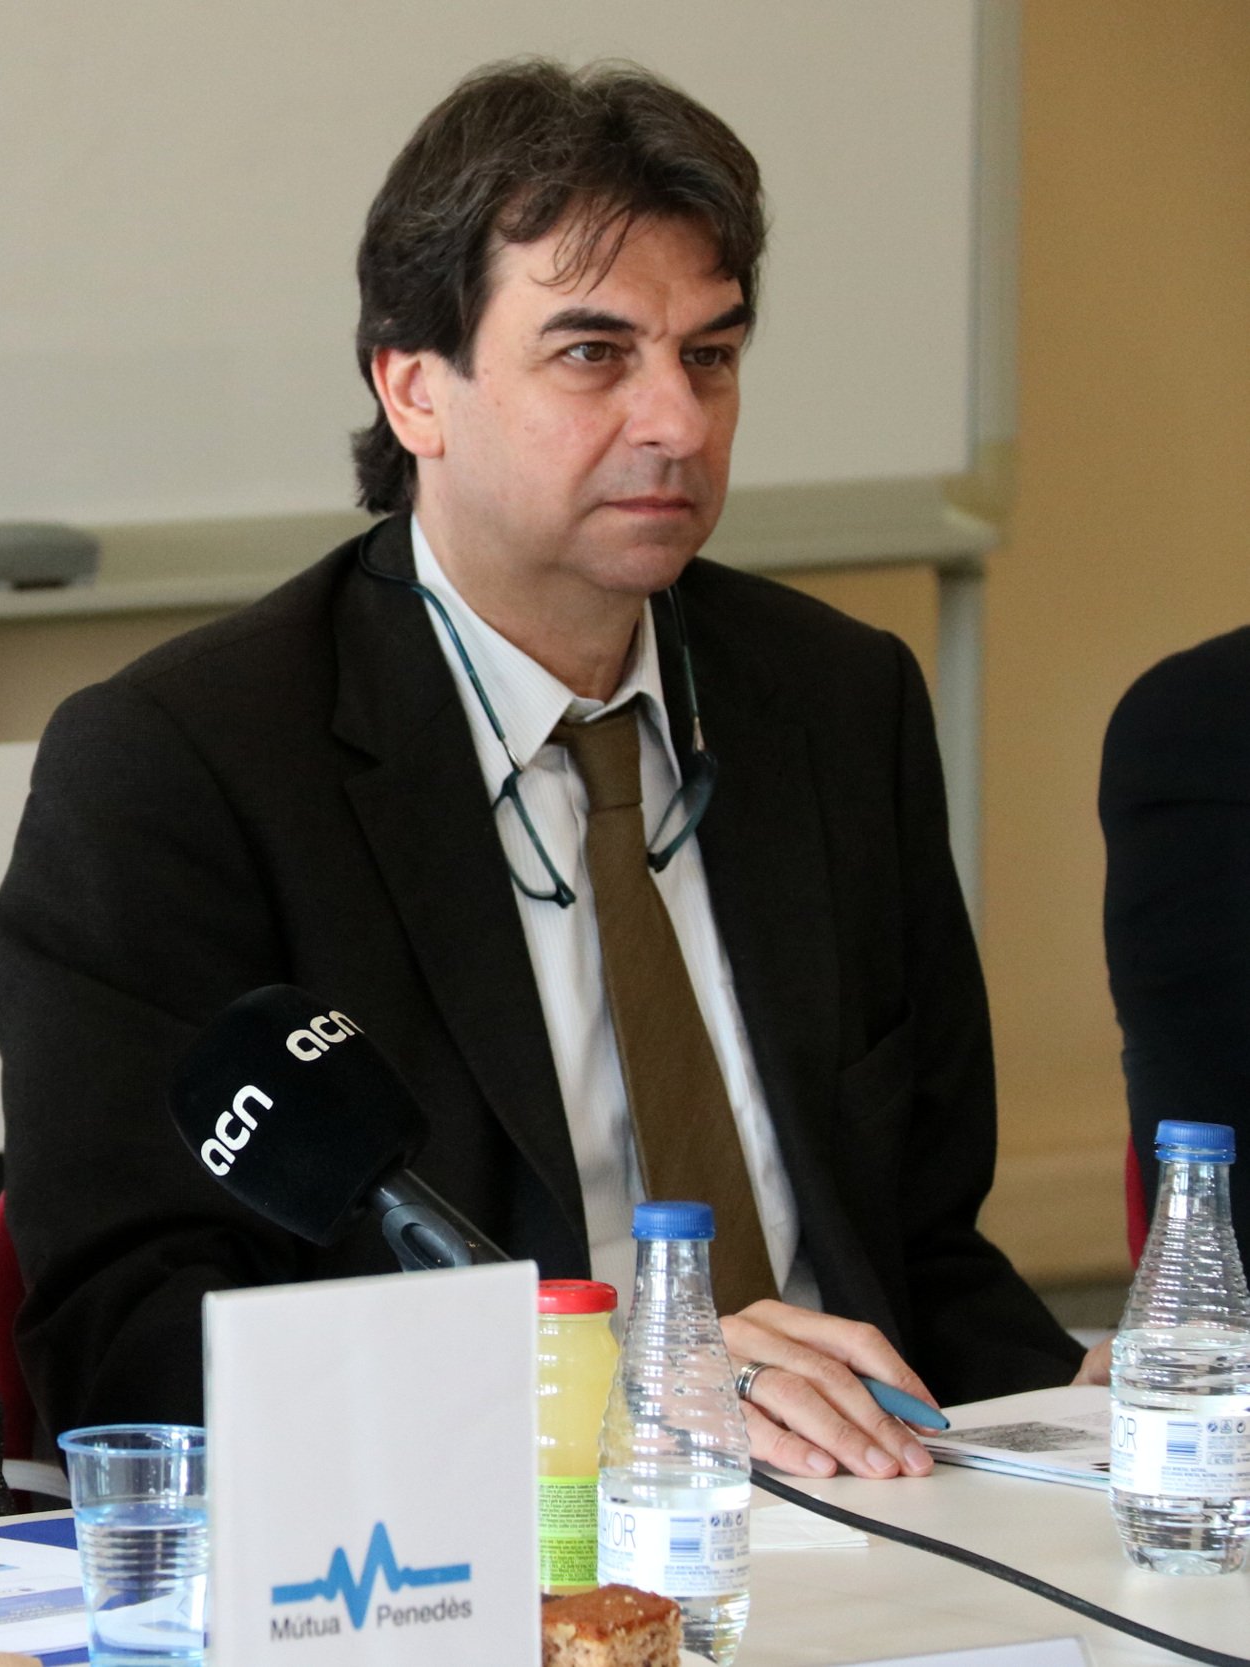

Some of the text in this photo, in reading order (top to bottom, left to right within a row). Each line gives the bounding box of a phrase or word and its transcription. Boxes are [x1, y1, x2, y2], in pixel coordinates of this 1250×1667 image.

[201, 1085, 274, 1176] acn
[269, 1597, 473, 1642] Mútua Penedès
